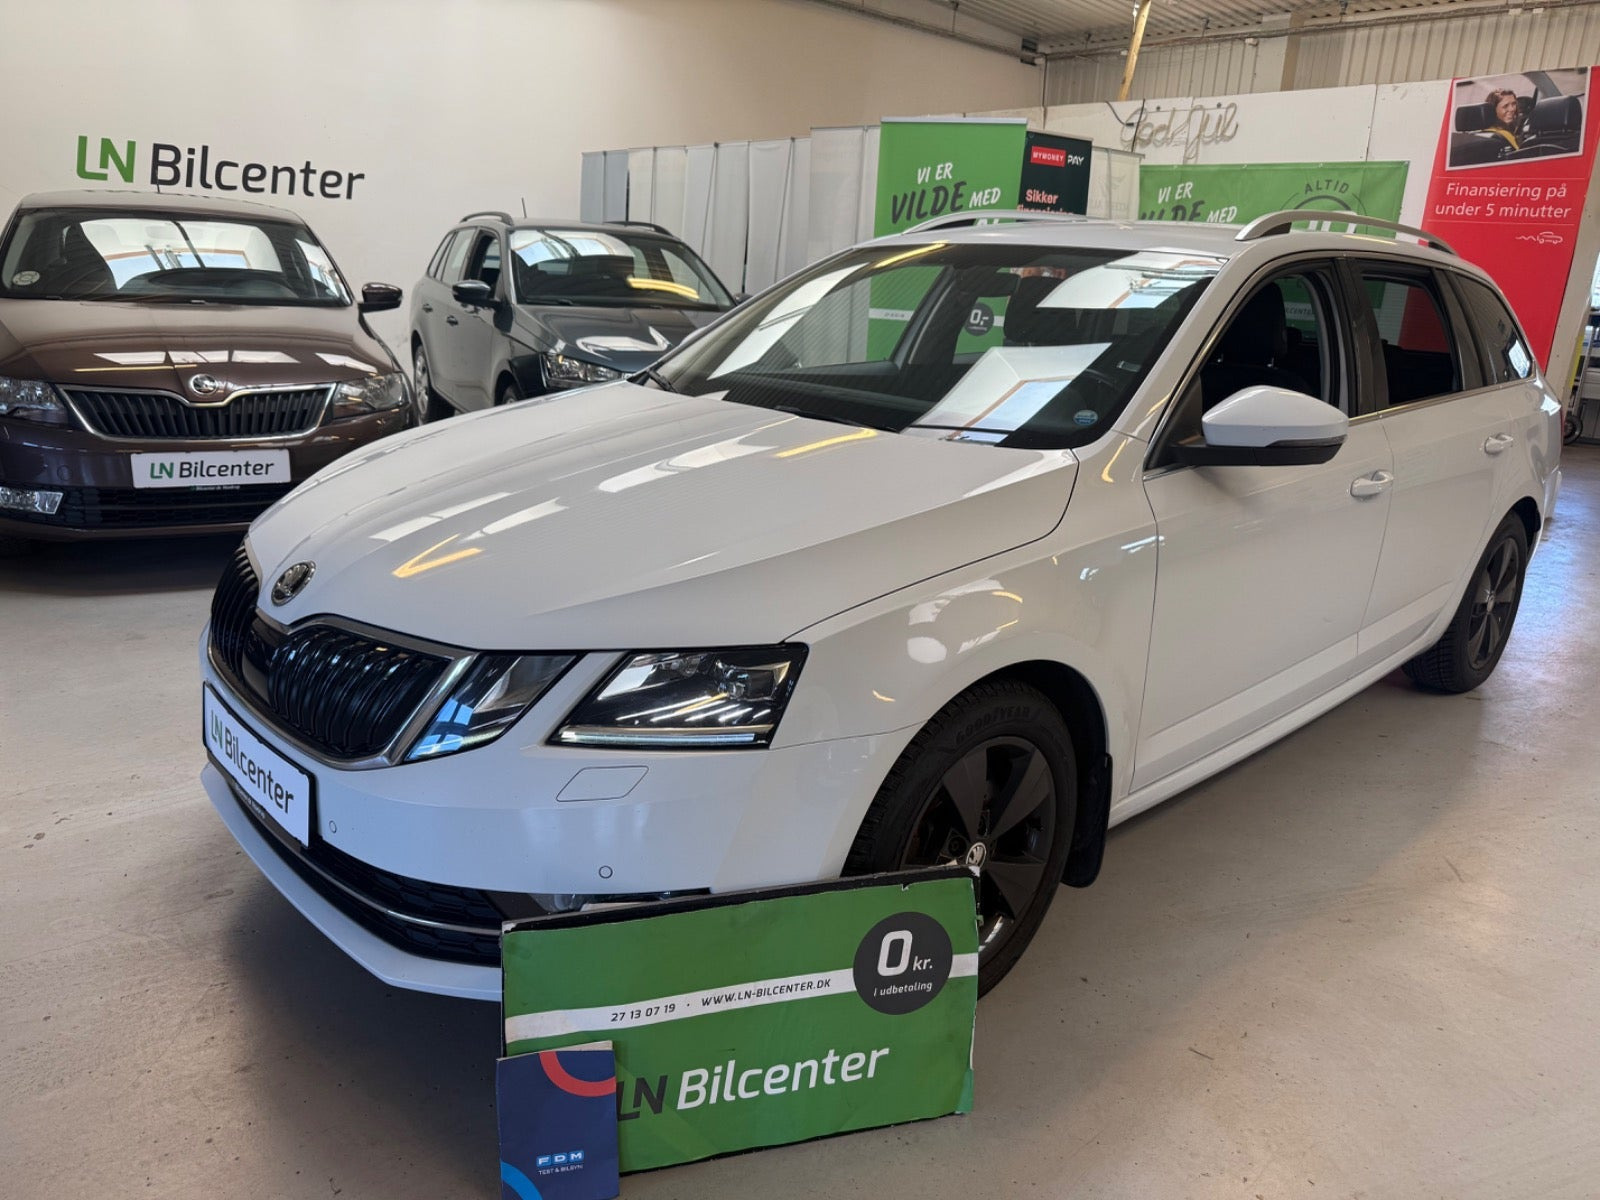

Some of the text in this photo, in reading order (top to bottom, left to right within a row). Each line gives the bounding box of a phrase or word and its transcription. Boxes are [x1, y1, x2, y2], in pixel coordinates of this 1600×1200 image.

[76, 135, 365, 200] LN Bilcenter
[1032, 151, 1085, 165] MYMONEY PAY
[917, 162, 953, 184] VI ER
[1025, 188, 1059, 204] Sikker
[1158, 181, 1193, 204] VI ER
[1304, 179, 1350, 195] ALTID
[1446, 183, 1567, 200] Finansiering på
[891, 181, 1001, 224] VILDE MED
[1435, 203, 1571, 218] under 5 minutter
[1206, 206, 1237, 223] MED
[150, 460, 275, 479] LN Bilcenter
[210, 710, 223, 749] LN
[224, 726, 294, 815] Bilcenter
[877, 930, 933, 977] 0 kr.
[880, 981, 933, 996] udbetaling
[611, 978, 831, 1022] 27 13 07 19 WWW.LN-BILCENTER.DK
[677, 1047, 890, 1110] Bilcenter
[537, 1152, 583, 1166] FDM
